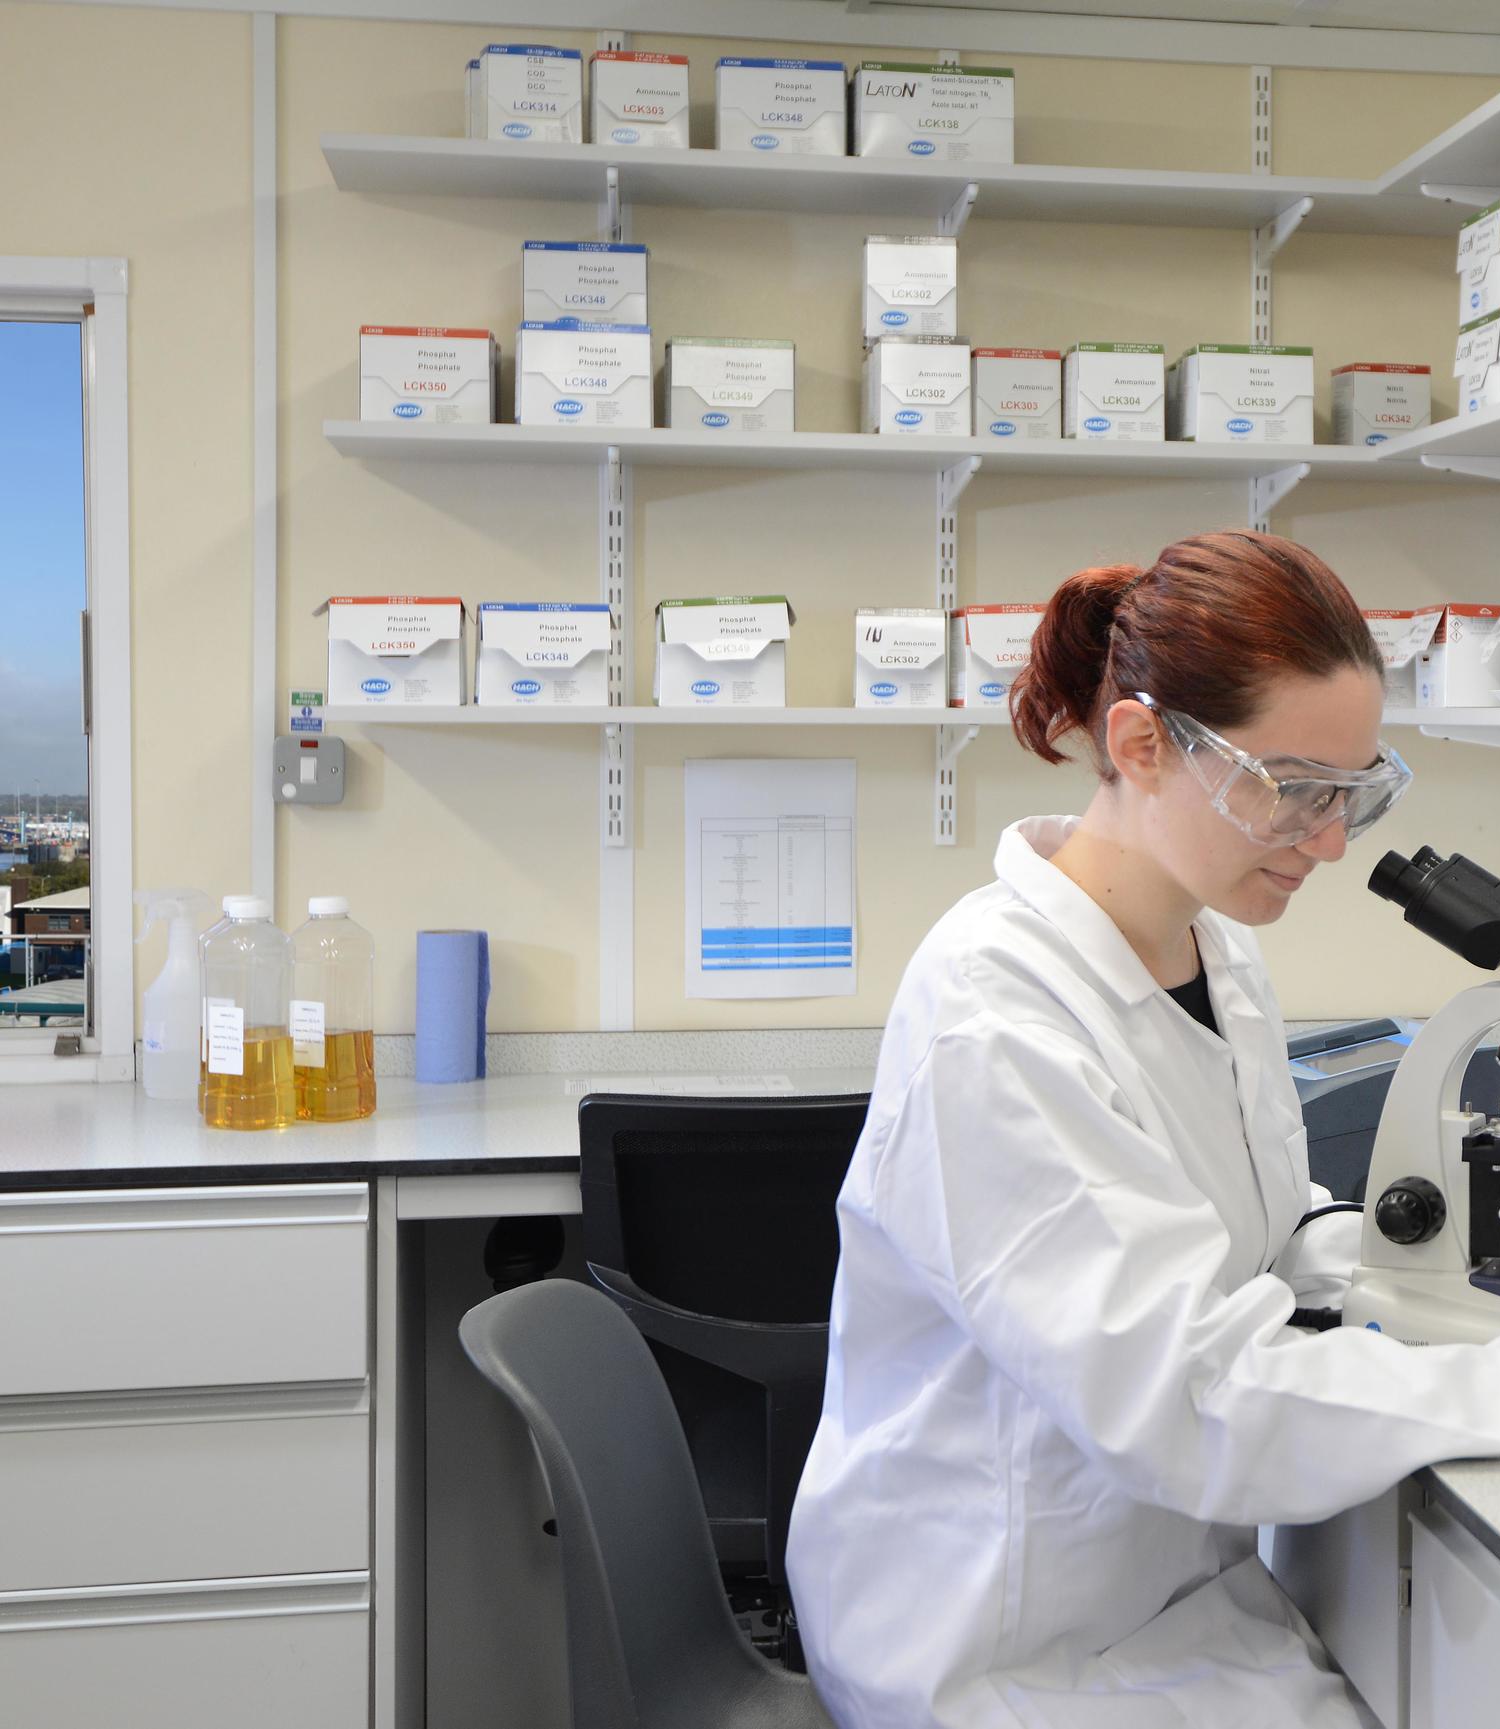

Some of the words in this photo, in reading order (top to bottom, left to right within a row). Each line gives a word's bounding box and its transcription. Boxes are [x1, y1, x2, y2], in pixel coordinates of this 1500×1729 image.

[527, 56, 544, 64] CSB
[775, 82, 812, 90] Phosphat
[636, 87, 681, 96] Ammonium
[775, 94, 816, 103] Phosphate
[513, 100, 556, 113] LCK314
[623, 104, 665, 116] LCK303
[761, 112, 803, 122] LCK348
[918, 118, 960, 129] LCK138
[503, 126, 532, 136] HACH
[612, 130, 639, 141] HACH
[752, 137, 779, 147] HACH
[909, 142, 936, 154] HACH
[578, 264, 615, 274] Phosphat
[904, 270, 948, 280] Ammonium
[578, 276, 619, 286] Phosphate
[564, 294, 606, 304] LCK348
[891, 289, 932, 299] LCK302
[882, 314, 908, 323] HACH
[418, 350, 456, 358] Phosphat
[578, 345, 617, 355] Phosphat
[418, 362, 461, 372] Phosphate
[578, 358, 622, 368] Phosphate
[725, 360, 762, 370] Phosphat
[918, 370, 962, 379] Ammonium
[1250, 367, 1270, 375] Nitrat
[725, 372, 766, 382] Phosphate
[1114, 377, 1157, 386] Ammonium
[404, 381, 447, 392] LCK350
[564, 377, 608, 388] LCK348
[1012, 382, 1054, 392] Ammonium
[1250, 379, 1274, 387] Nitrate
[712, 390, 753, 401] LCK349
[906, 388, 946, 399] LCK302
[1000, 400, 1038, 410] LCK303
[1102, 396, 1141, 406] LCK304
[1237, 397, 1277, 407] LCK339
[394, 406, 422, 416] HACH
[553, 402, 584, 413] HACH
[702, 415, 730, 425] HACH
[895, 413, 922, 423] HACH
[1375, 414, 1411, 424] LCK342
[990, 424, 1016, 434] HACH
[1084, 420, 1111, 430] HACH
[1228, 422, 1253, 431] HACH
[719, 616, 757, 624] Phosphat
[539, 624, 577, 632] Phosphat
[720, 627, 762, 635] Phosphate
[539, 636, 583, 644] Phosphate
[371, 641, 416, 650] LCK350
[708, 643, 751, 654] LCK349
[526, 652, 569, 661] LCK348
[880, 655, 920, 664] LCK302
[996, 652, 1032, 662] LCK30
[362, 682, 390, 691] HACH
[512, 683, 540, 692] HACH
[692, 684, 720, 692] HACH
[871, 686, 898, 694] HACH
[1400, 1339, 1429, 1347] scopes
